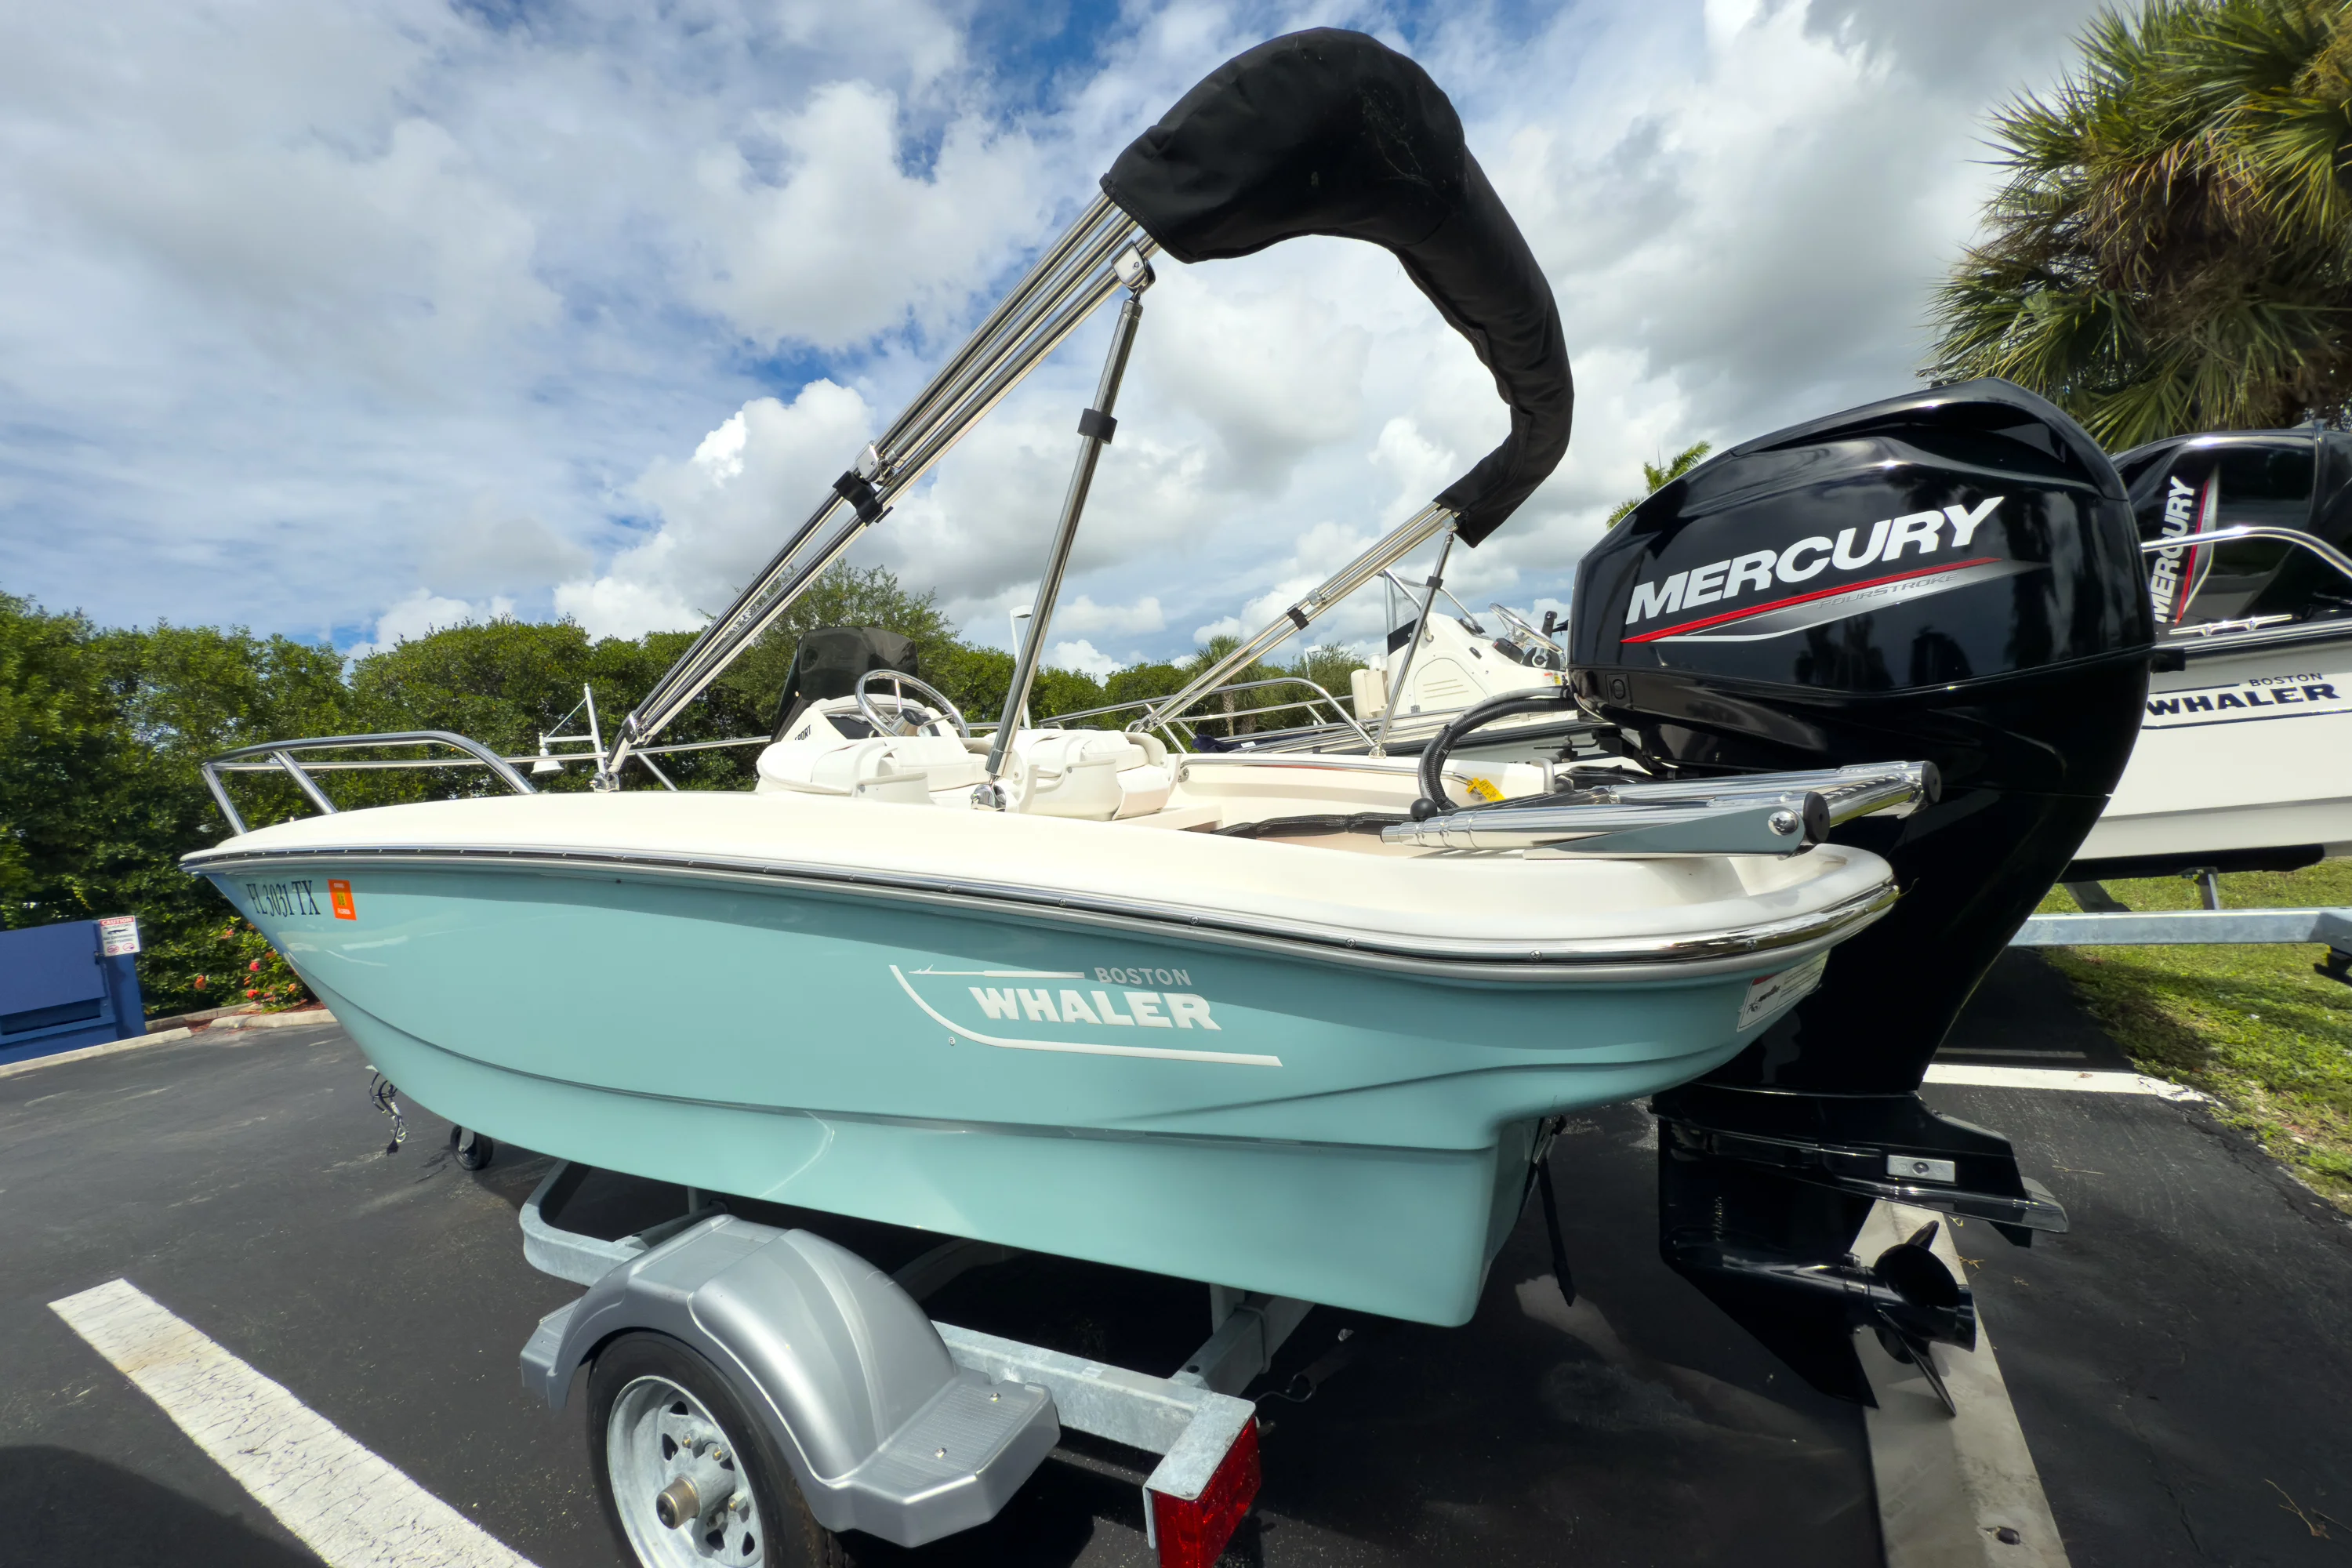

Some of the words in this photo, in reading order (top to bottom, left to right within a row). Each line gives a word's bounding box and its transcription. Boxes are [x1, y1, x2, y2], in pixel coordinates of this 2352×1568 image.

[1625, 495, 2005, 625] MERCURY
[1817, 572, 1958, 609] FOURSTROKE
[2249, 672, 2324, 687] BOSTON
[2147, 683, 2341, 716] WHALER
[245, 883, 268, 914] FL
[262, 883, 295, 917] 3031
[291, 880, 321, 915] TX
[101, 916, 133, 925] CAUTION
[1094, 967, 1192, 985] BOSTON
[967, 986, 1222, 1030] WHALER
